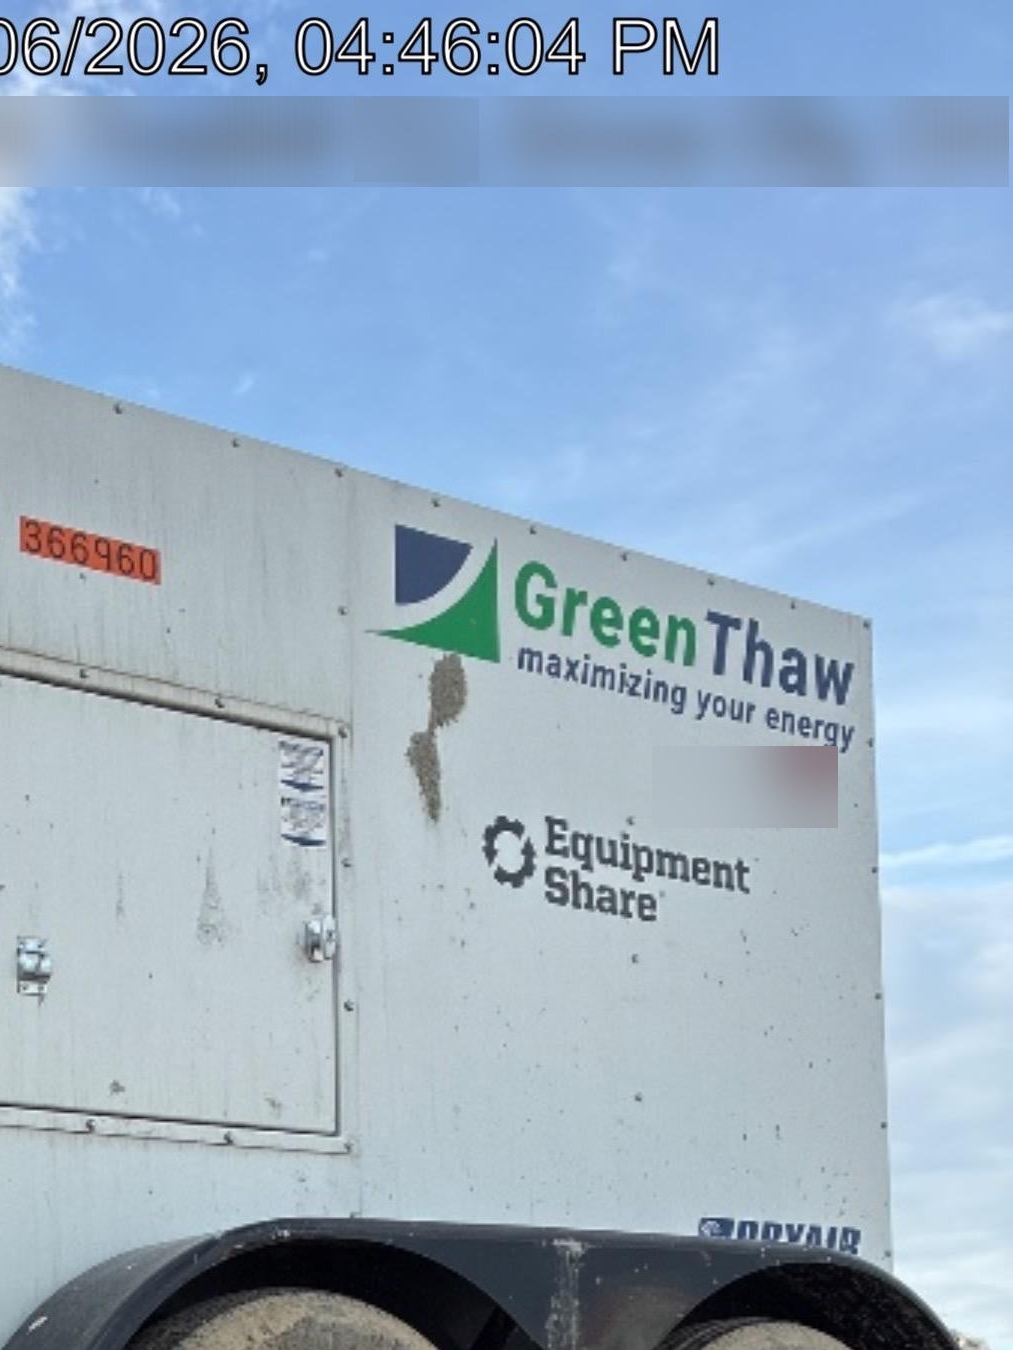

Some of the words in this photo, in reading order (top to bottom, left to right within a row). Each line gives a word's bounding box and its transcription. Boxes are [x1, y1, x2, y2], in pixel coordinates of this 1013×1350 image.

[24, 519, 157, 581] 366960
[517, 647, 688, 715] maximizing
[695, 689, 756, 724] your
[765, 707, 855, 753] energy
[544, 815, 751, 895] Equipment
[544, 865, 658, 921] Share
